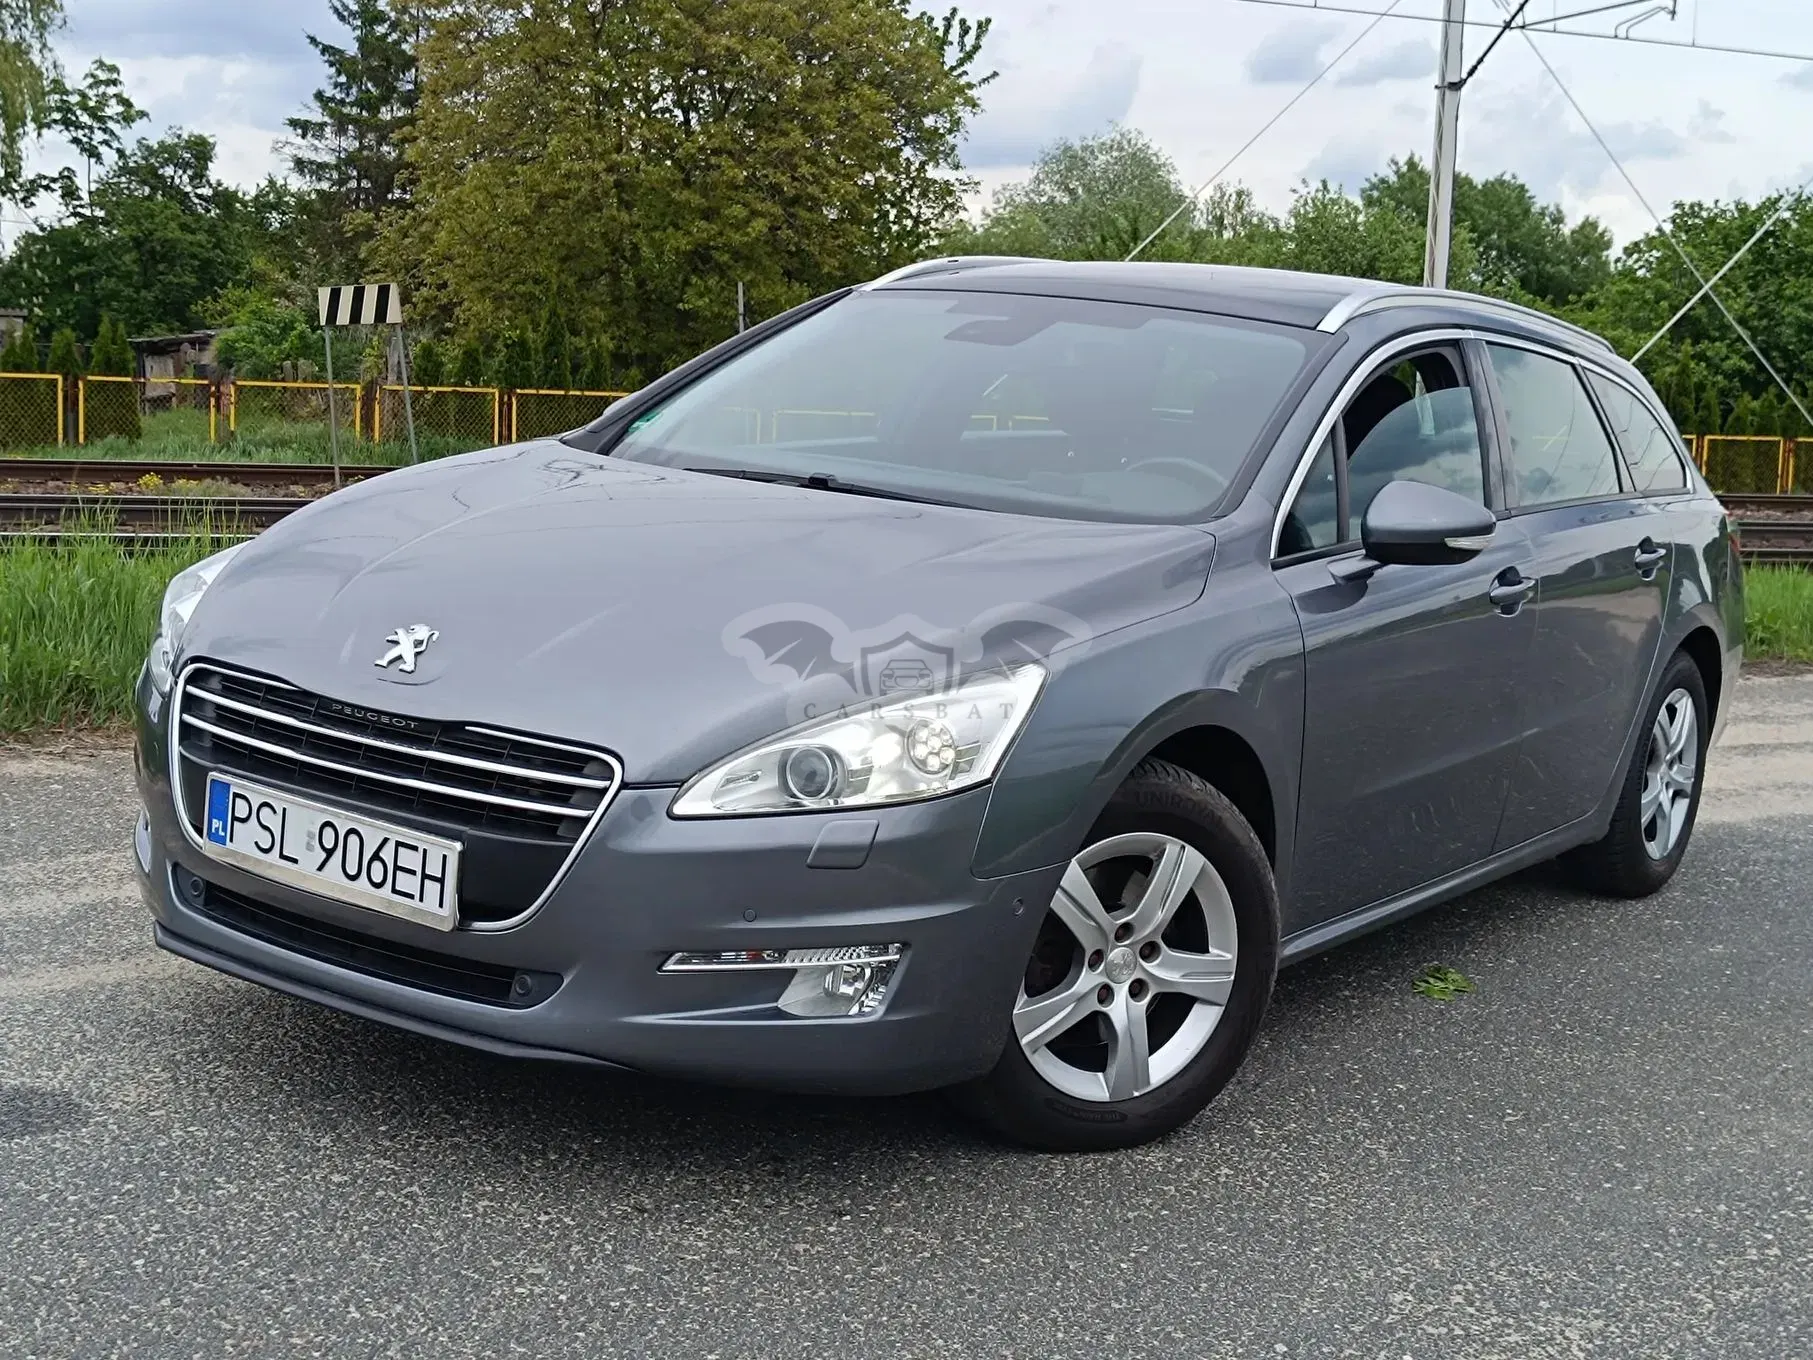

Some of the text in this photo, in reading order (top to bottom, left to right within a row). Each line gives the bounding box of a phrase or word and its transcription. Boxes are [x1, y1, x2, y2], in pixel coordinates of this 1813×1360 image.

[331, 703, 418, 728] PEUGEOT
[211, 818, 225, 836] PL
[229, 791, 448, 909] PSL 906EH
